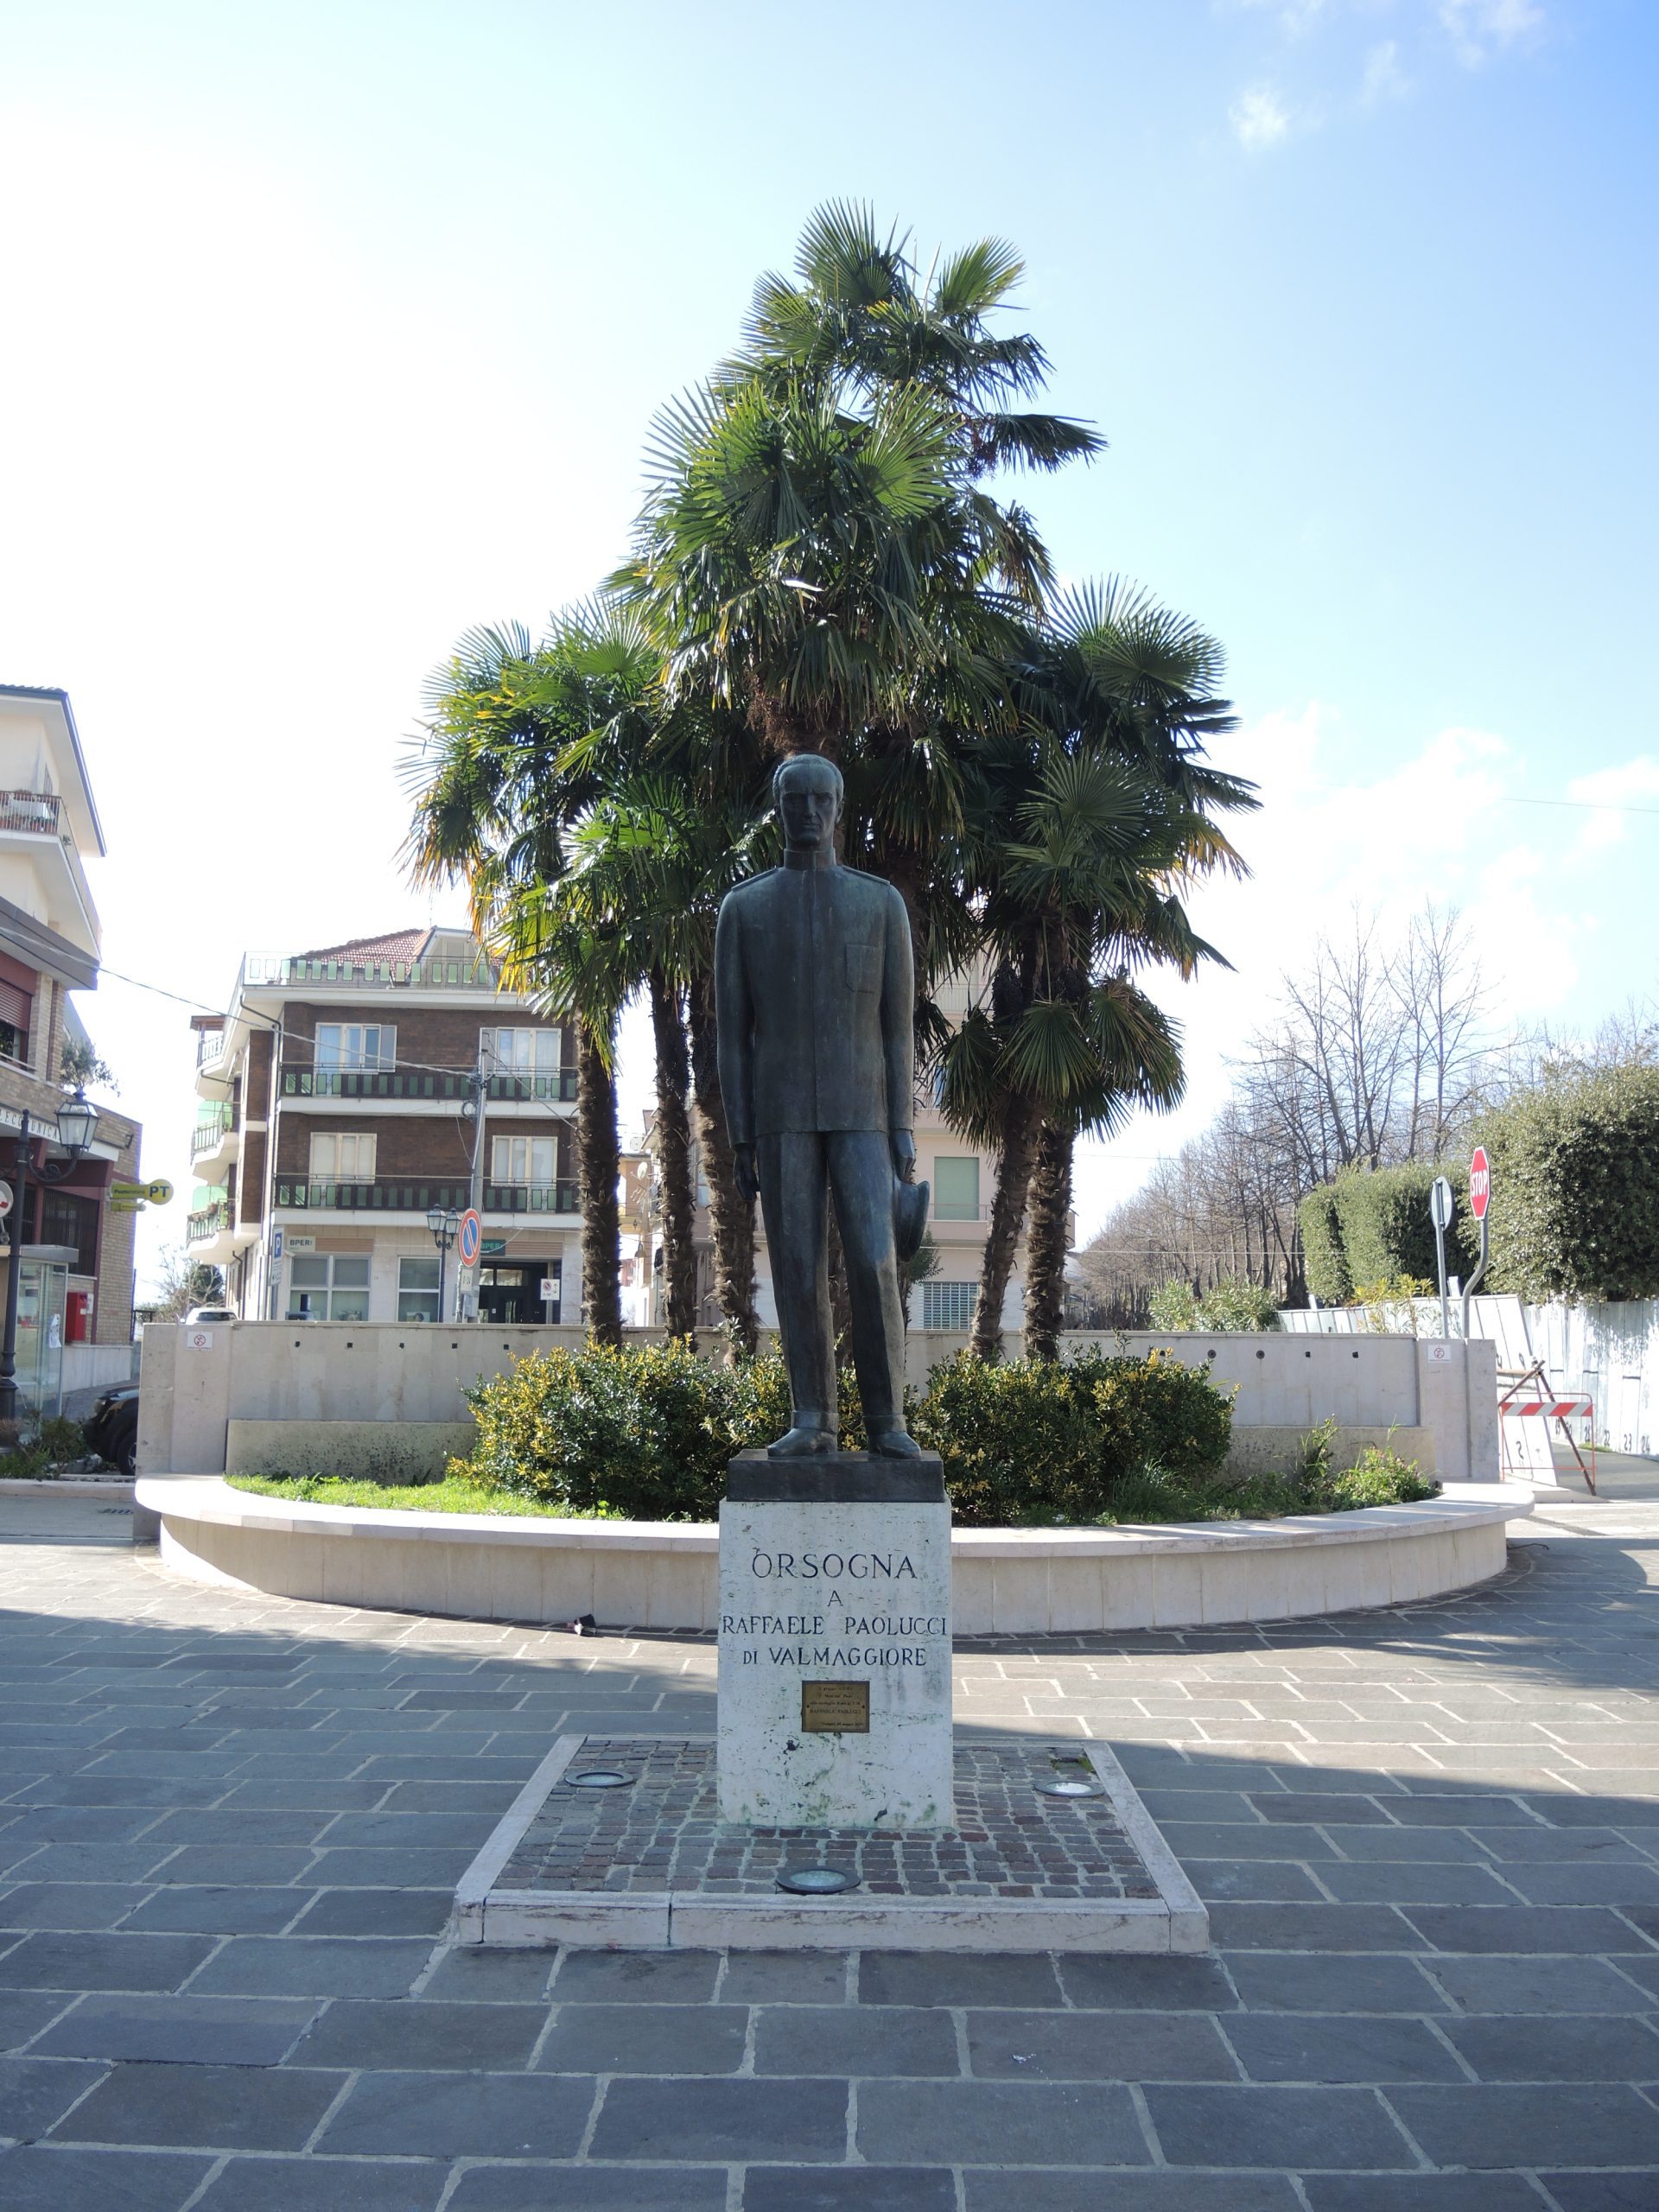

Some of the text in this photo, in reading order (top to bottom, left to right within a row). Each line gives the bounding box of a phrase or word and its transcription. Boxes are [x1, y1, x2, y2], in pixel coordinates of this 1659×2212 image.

[149, 1185, 169, 1198] PT
[1471, 1169, 1487, 1198] STOP
[276, 1236, 281, 1255] P
[1624, 1433, 1632, 1452] 23
[752, 1553, 918, 1579] ORSOGNA
[827, 1590, 843, 1607] A
[722, 1615, 947, 1636] RAFFAELE PAOLUCCI
[743, 1647, 927, 1666] DI VALMAGGIORE
